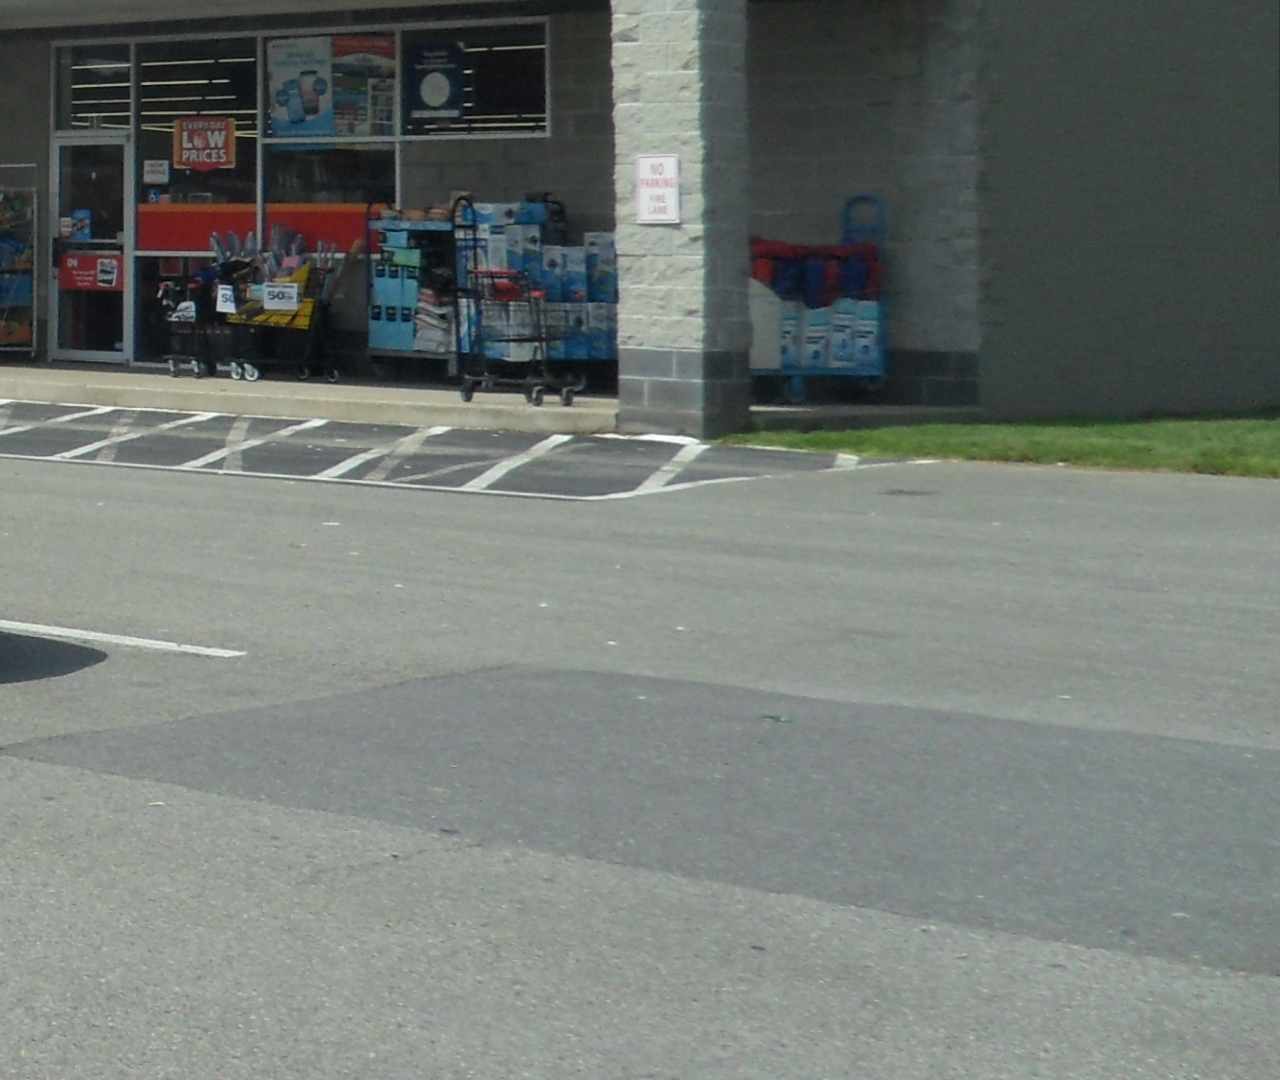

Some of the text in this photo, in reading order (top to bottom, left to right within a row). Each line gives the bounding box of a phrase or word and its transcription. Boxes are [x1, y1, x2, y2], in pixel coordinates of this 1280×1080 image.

[182, 130, 227, 149] LOW
[182, 148, 227, 162] PRICES
[650, 162, 664, 176] NO
[640, 177, 676, 189] PARKING
[649, 194, 665, 204] FIRE
[648, 205, 667, 215] LANE
